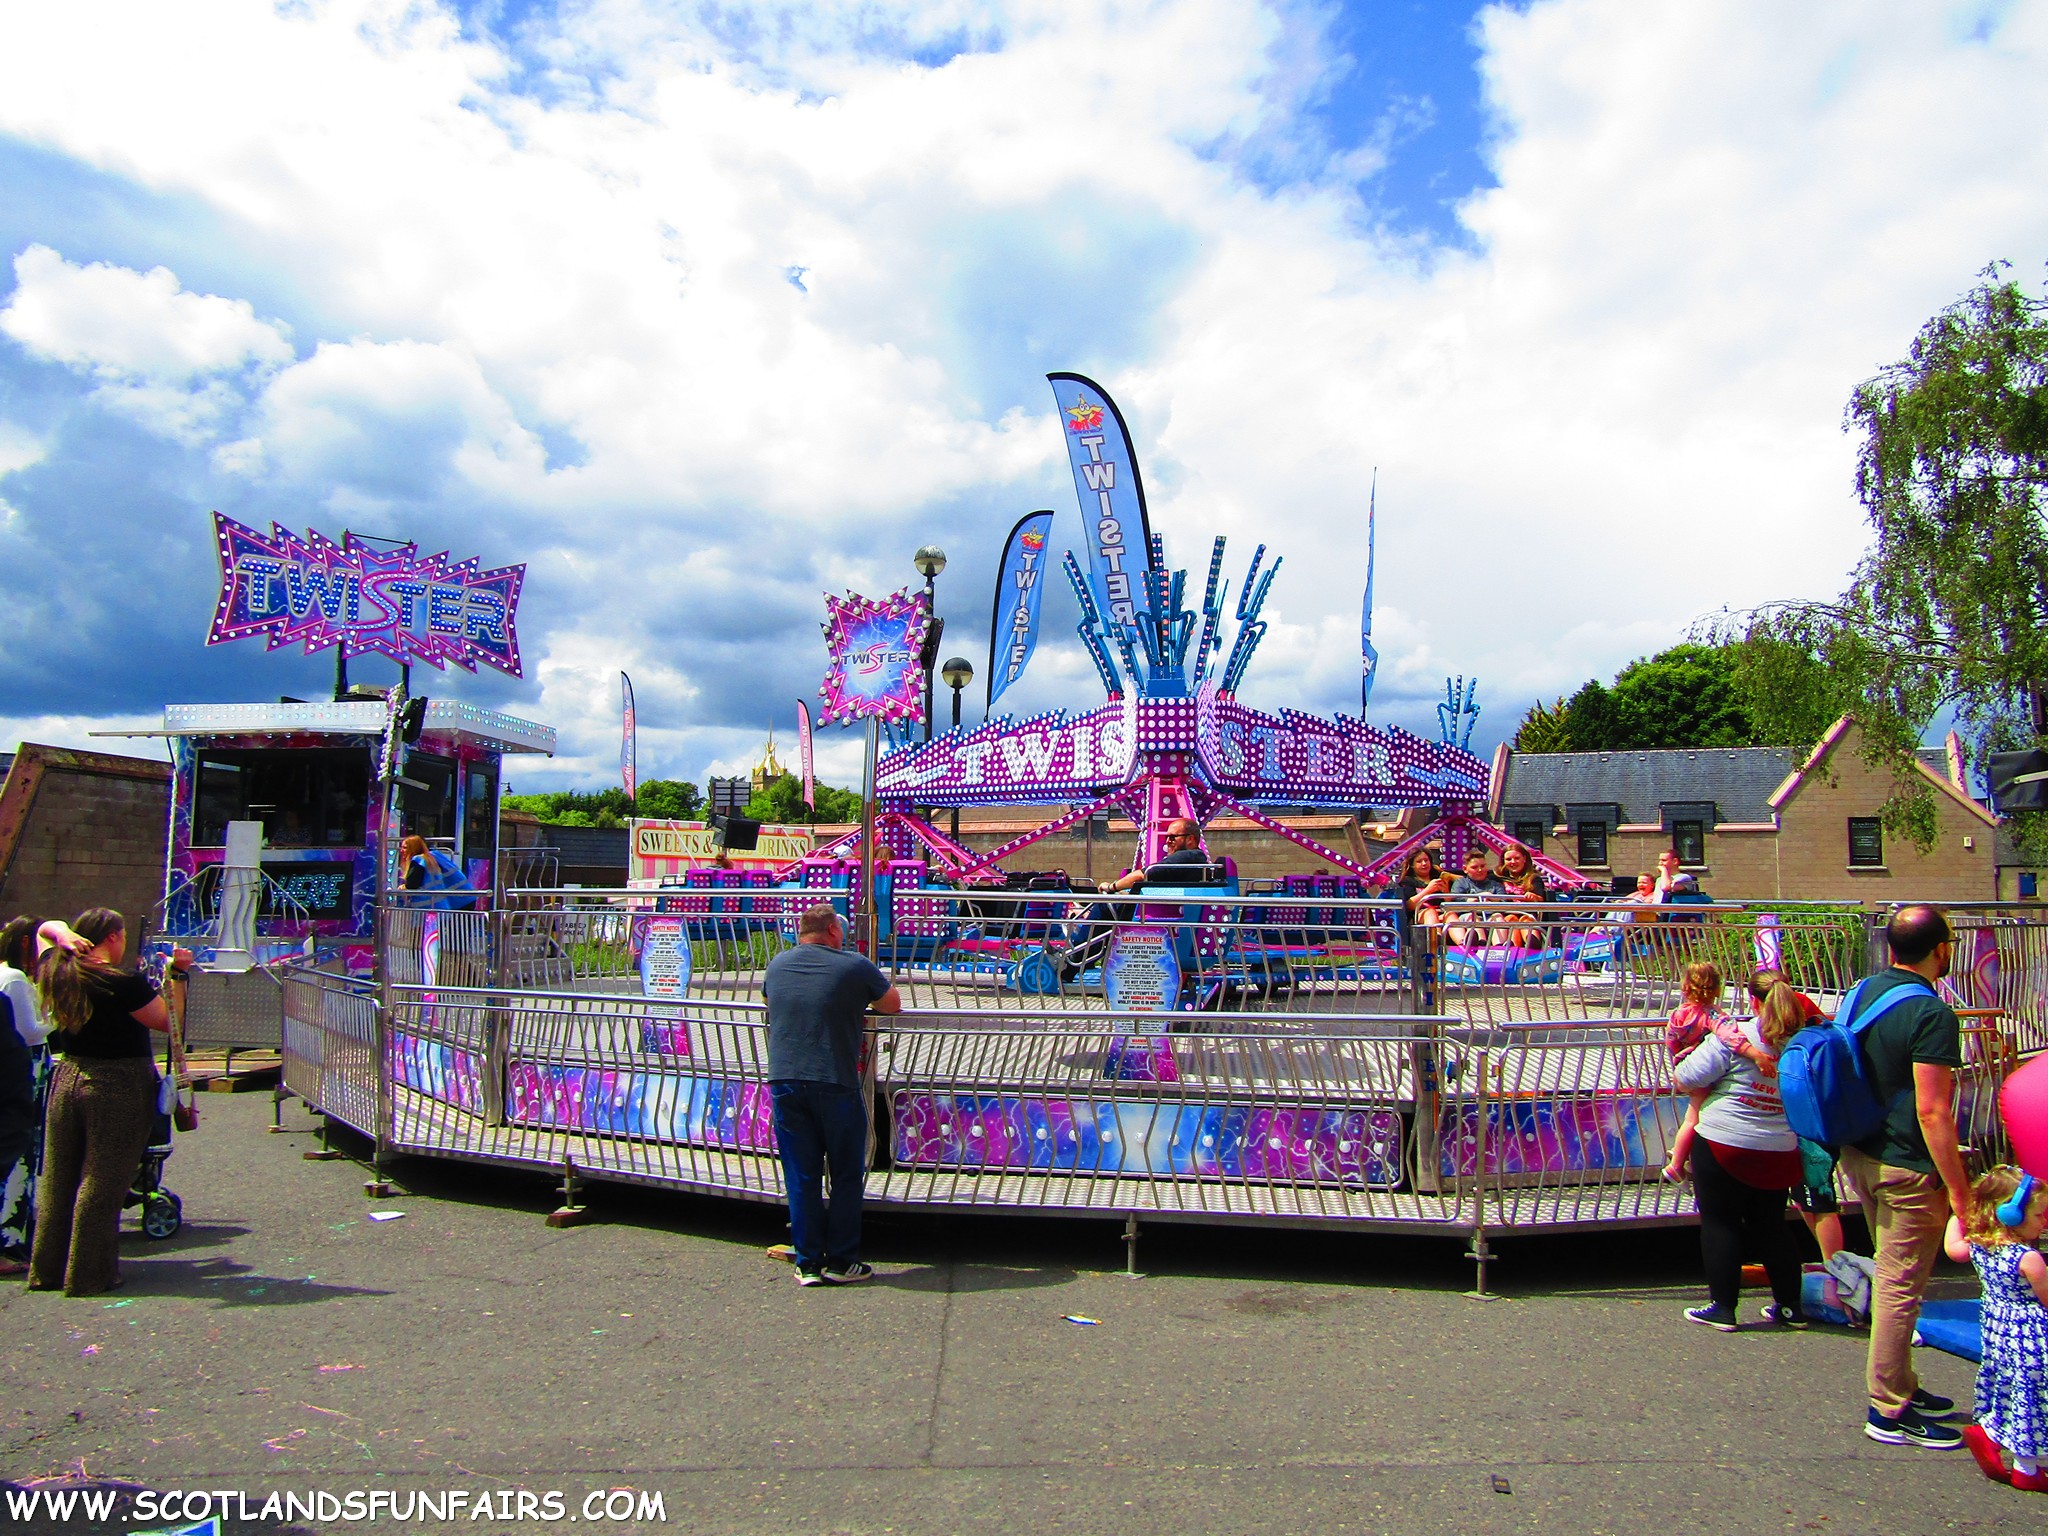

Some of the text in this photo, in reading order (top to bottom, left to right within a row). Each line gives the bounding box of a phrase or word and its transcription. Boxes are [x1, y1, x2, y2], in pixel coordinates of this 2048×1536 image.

[234, 554, 509, 643] TWISTER
[841, 643, 911, 675] TWISTER
[641, 831, 699, 854] SWEETS
[703, 835, 713, 854] &
[757, 838, 806, 857] DRINKS
[270, 873, 346, 909] HERE
[1027, 968, 1049, 985] 10
[1750, 1081, 1777, 1095] NEW
